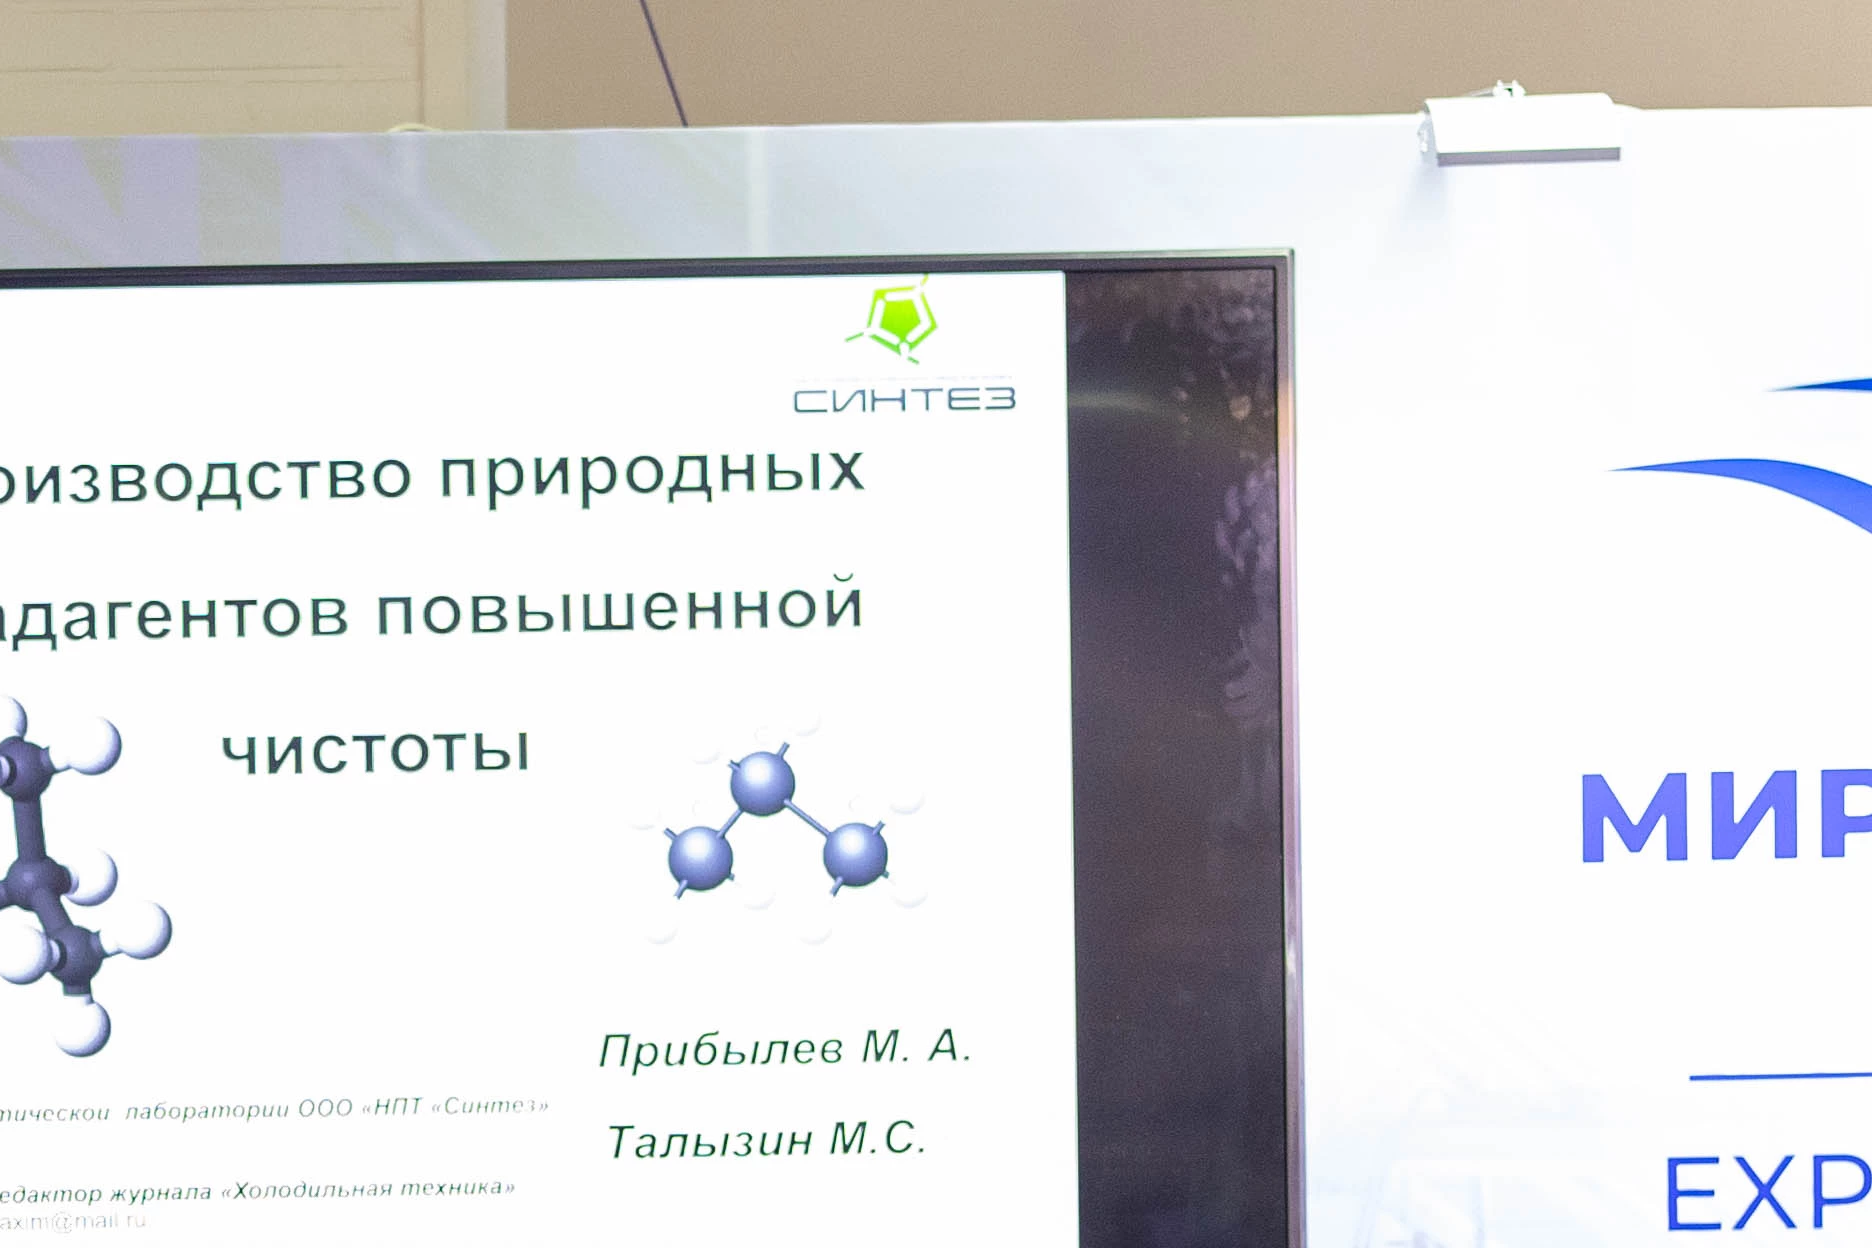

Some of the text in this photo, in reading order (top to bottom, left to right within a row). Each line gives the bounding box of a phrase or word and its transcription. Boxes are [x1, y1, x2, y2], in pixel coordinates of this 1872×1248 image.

[793, 387, 1017, 413] СИНТЕЗ
[441, 451, 866, 512] природных
[378, 572, 863, 636] повышенной
[221, 731, 529, 776] чистоты
[1581, 769, 1872, 863] МИР
[598, 1027, 970, 1077] Прибылев М. А.
[125, 1102, 289, 1124] лаборатории
[298, 1098, 353, 1117] ООО
[608, 1119, 925, 1159] Талызин М.С.
[109, 1186, 212, 1206] журнала
[221, 1180, 393, 1200] «Холодильная
[400, 1180, 515, 1197] техника»
